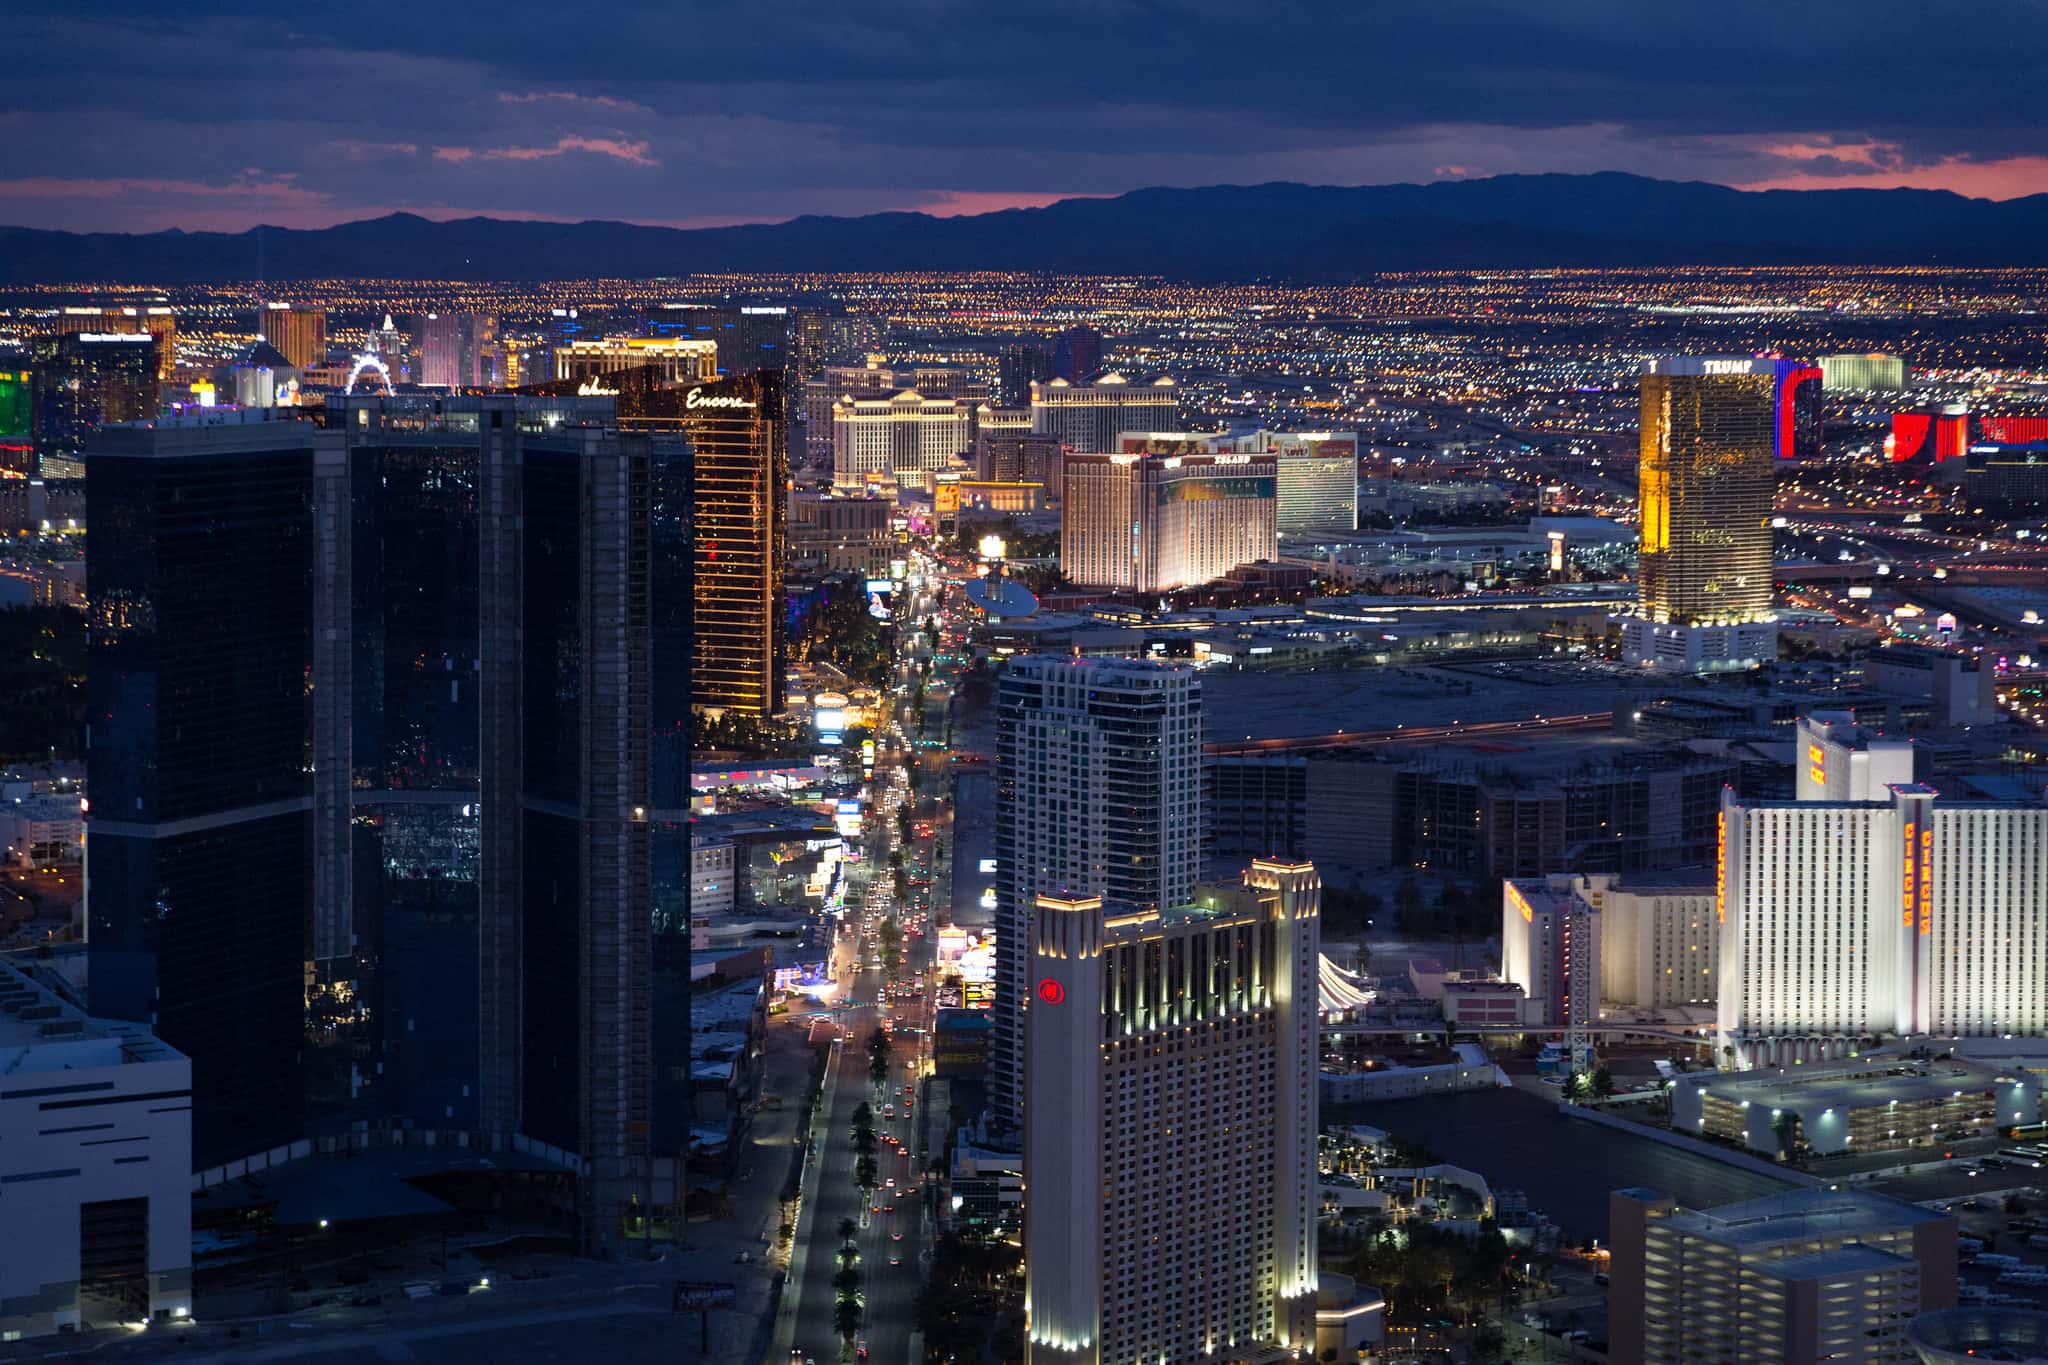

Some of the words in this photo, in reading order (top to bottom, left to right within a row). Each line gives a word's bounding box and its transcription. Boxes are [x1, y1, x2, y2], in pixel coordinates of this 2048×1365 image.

[1648, 360, 1657, 374] T
[1702, 360, 1752, 374] TRUMP
[686, 387, 757, 409] Encore
[1903, 823, 1914, 928] CIRCUS
[1920, 830, 1932, 935] CIRCUS
